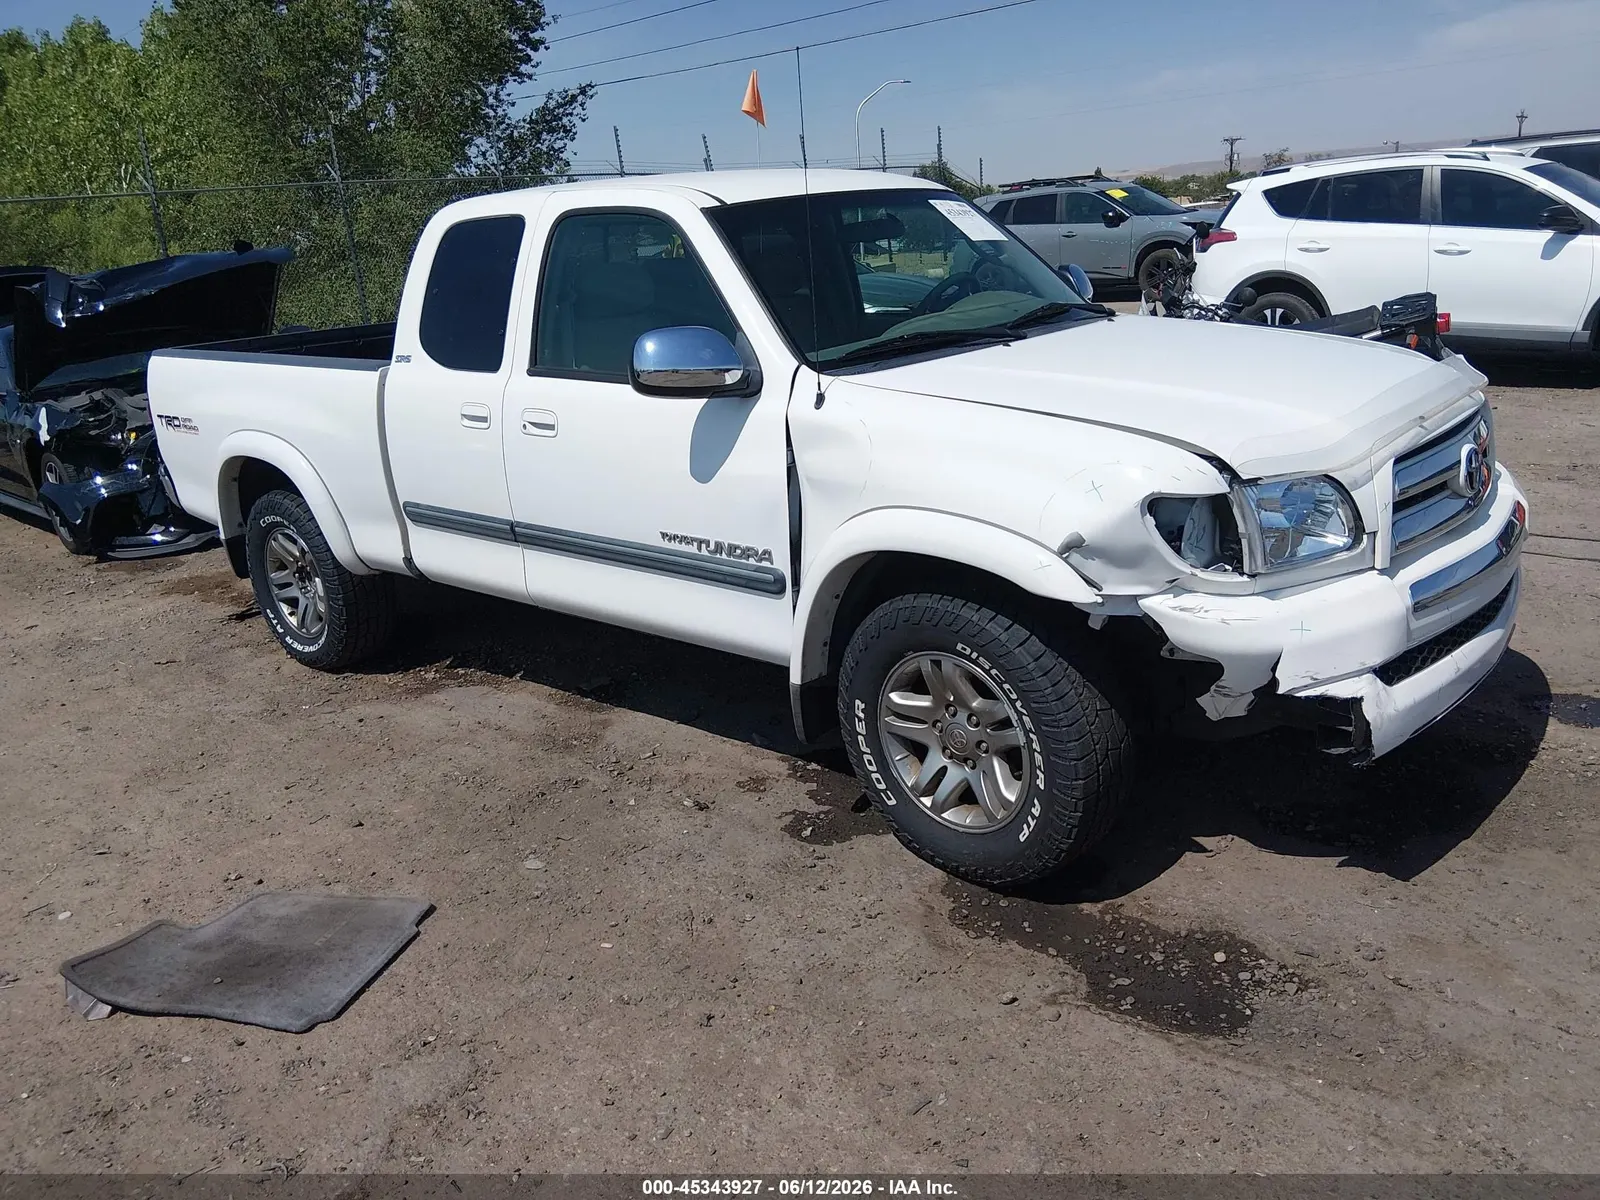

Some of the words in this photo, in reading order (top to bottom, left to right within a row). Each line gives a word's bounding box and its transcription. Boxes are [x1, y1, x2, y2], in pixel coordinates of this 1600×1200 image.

[156, 413, 181, 432] TRD
[690, 537, 774, 566] TUNDRA
[854, 697, 898, 807] COOPER
[955, 641, 1046, 792] DISCOVERER
[1018, 797, 1043, 843] ATP
